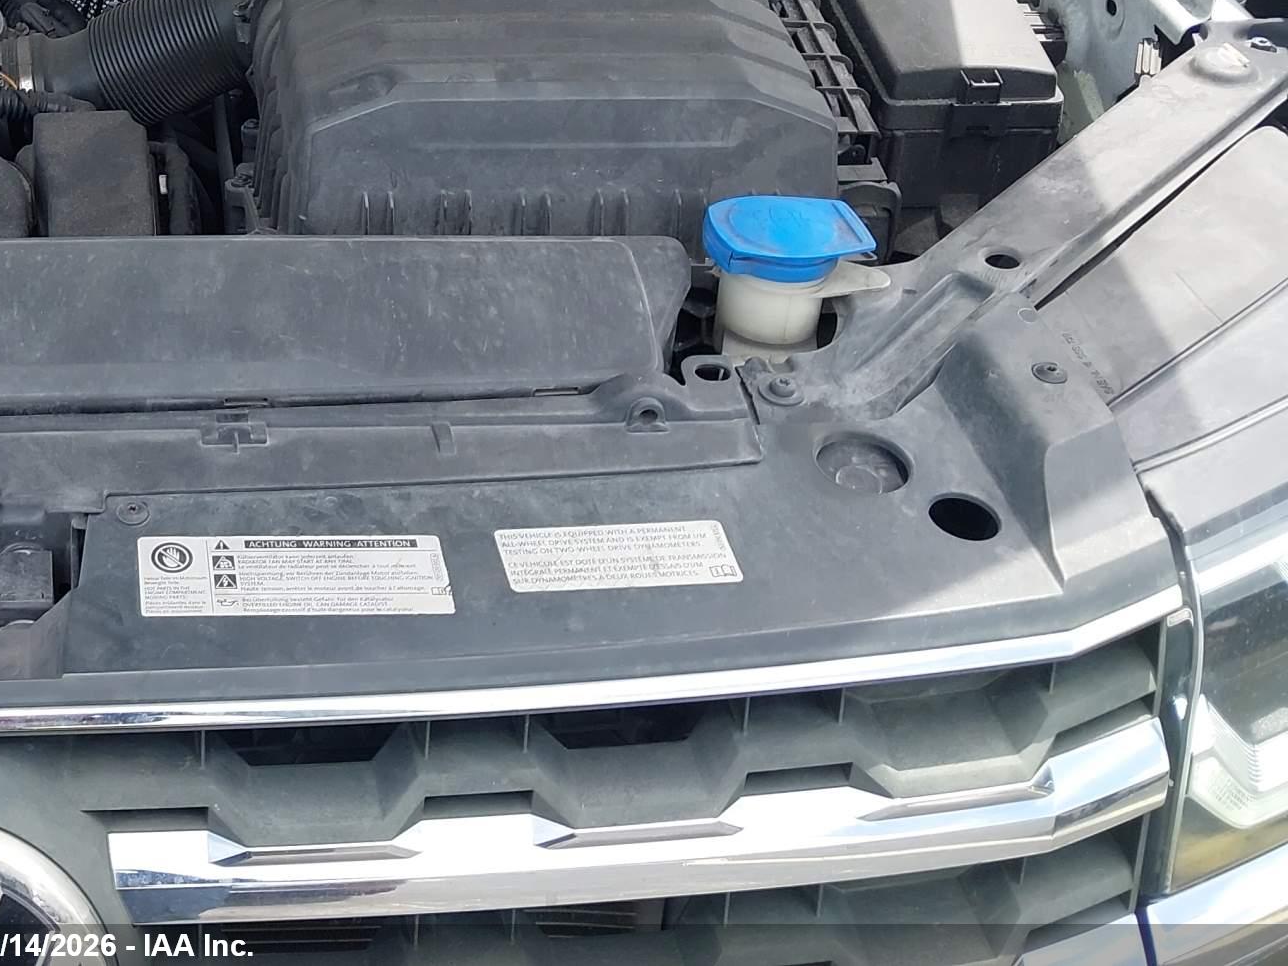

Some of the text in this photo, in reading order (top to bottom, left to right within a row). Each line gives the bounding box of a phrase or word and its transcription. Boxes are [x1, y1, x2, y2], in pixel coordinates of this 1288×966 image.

[249, 540, 411, 548] ACHTUNG WARNING ATTENTION
